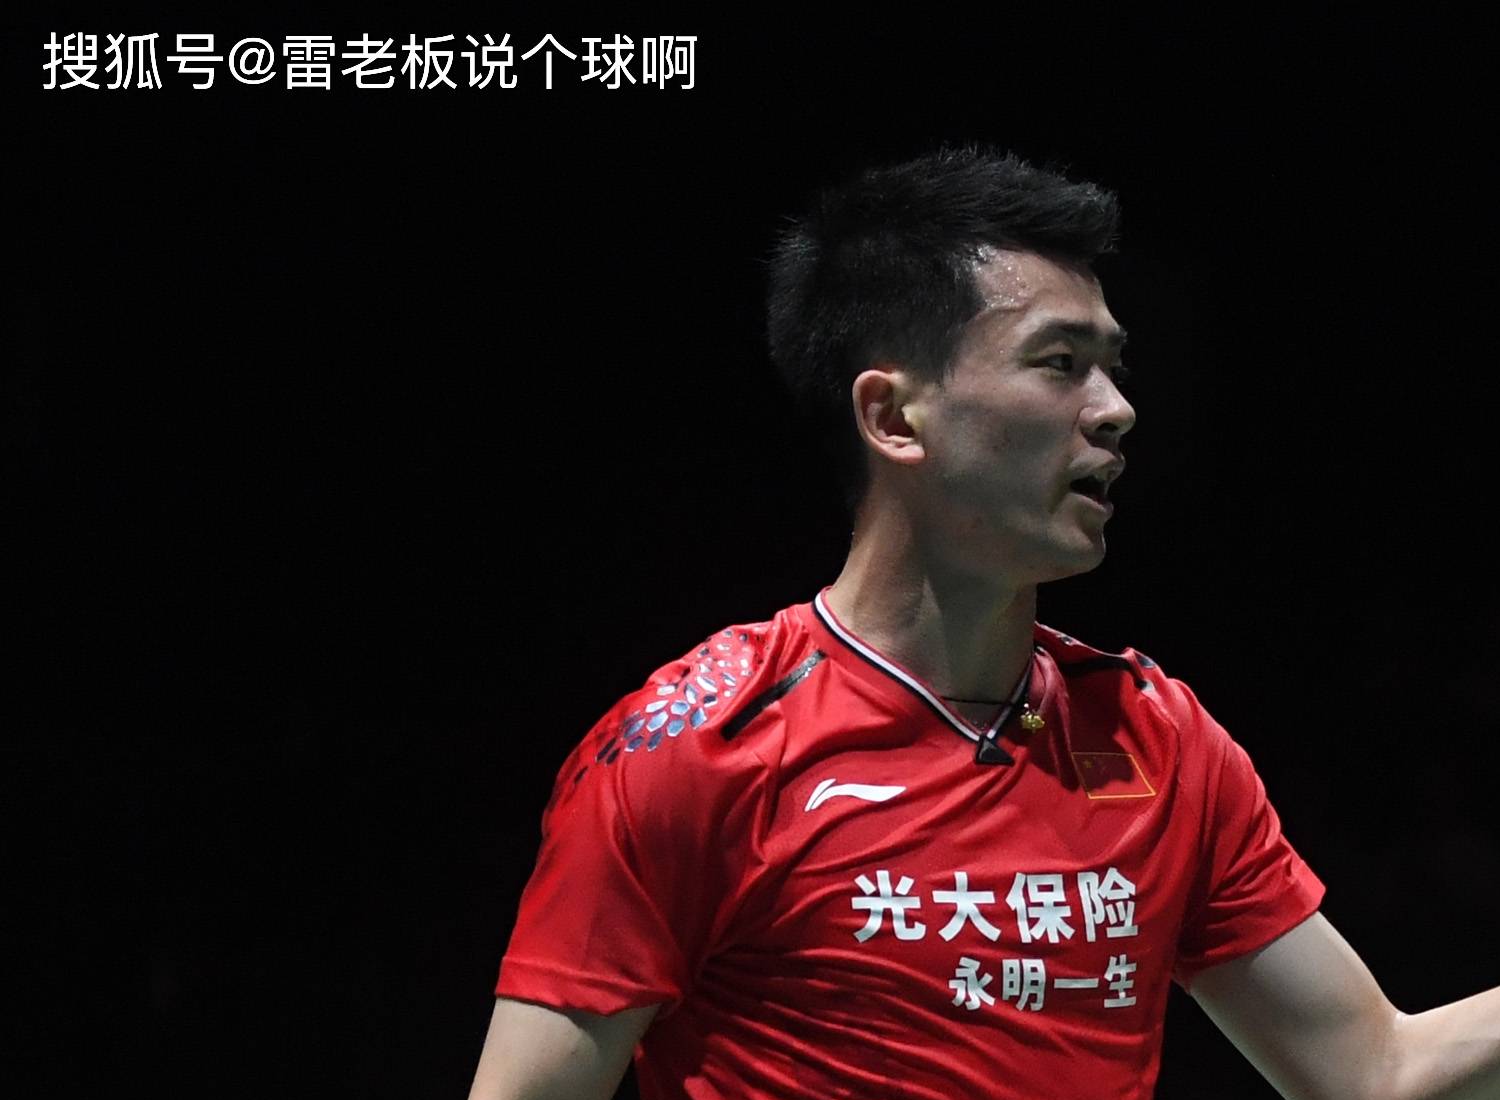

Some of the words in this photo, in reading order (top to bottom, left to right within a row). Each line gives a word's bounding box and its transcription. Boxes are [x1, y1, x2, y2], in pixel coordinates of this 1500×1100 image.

[851, 867, 1138, 944] 光大保险
[948, 953, 1138, 1012] 永明一生
